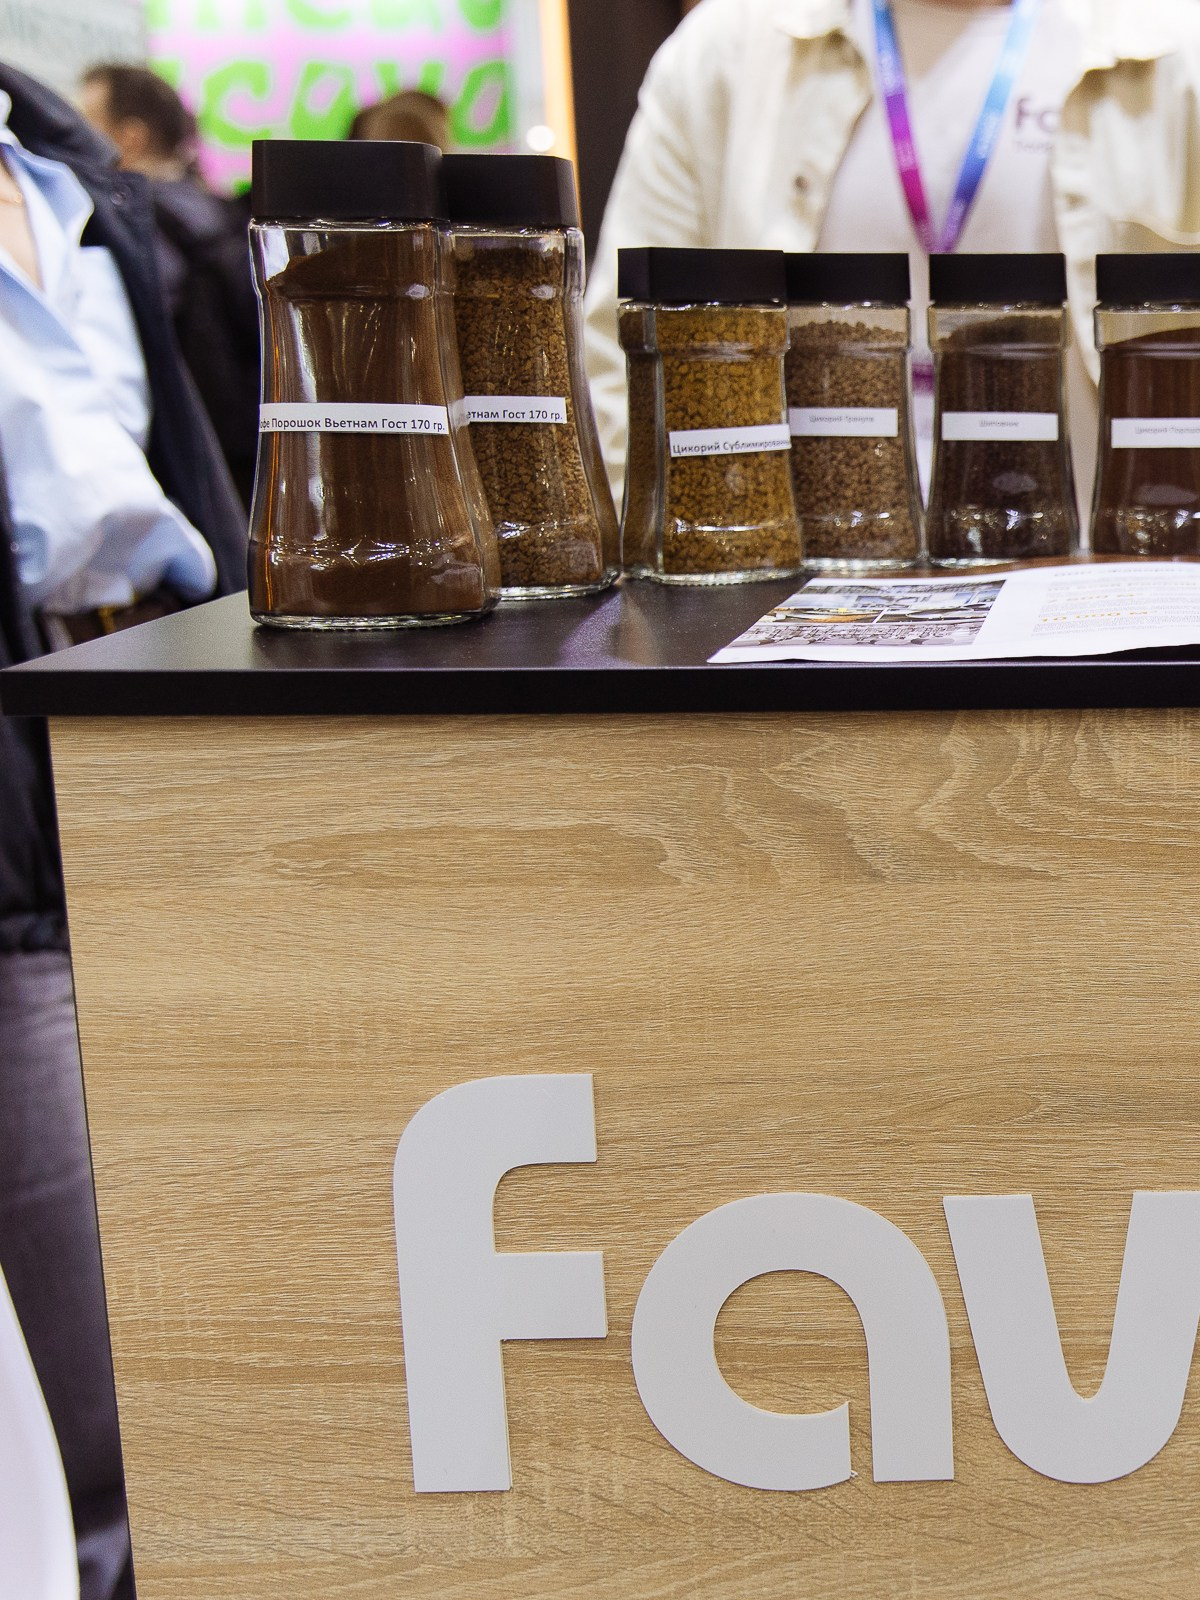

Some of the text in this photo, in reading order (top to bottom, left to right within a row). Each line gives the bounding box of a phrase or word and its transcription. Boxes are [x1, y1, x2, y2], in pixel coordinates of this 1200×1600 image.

[502, 409, 526, 420] Гост
[529, 410, 548, 420] 170
[272, 418, 321, 430] Порошок
[324, 418, 378, 429] Вьетнам
[381, 418, 407, 429] Гост
[411, 419, 431, 430] 170
[672, 441, 721, 455] Цикорий
